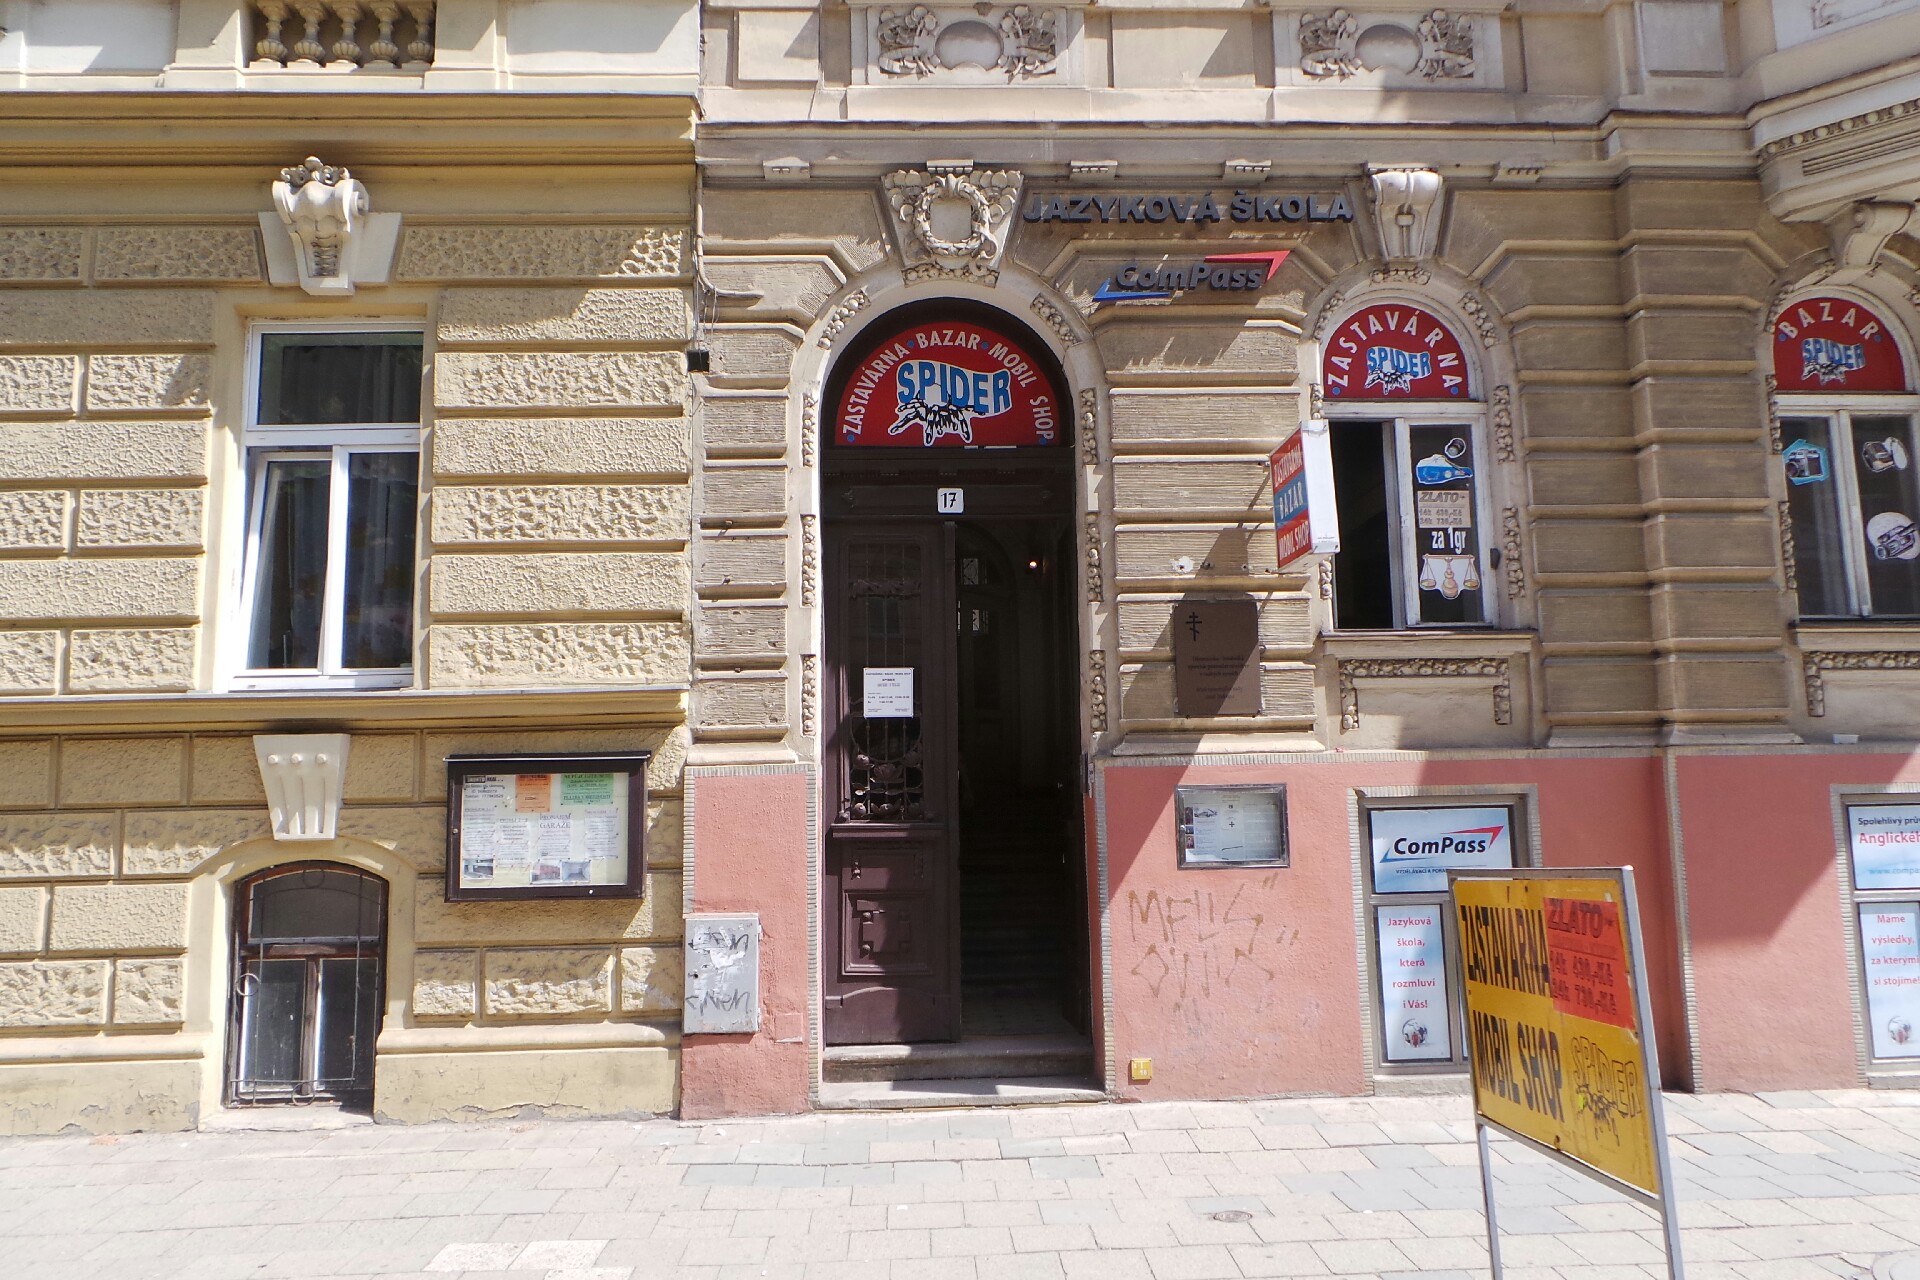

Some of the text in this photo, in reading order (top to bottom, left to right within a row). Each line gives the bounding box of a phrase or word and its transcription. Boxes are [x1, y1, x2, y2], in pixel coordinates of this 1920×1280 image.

[1023, 190, 1353, 224] JAZYKOVÁ ŠKOLA
[1115, 261, 1265, 290] ComPass
[1778, 302, 1879, 340] BAZAR
[1328, 310, 1462, 388] ZASTAVÁRNA
[1368, 347, 1430, 378] SPIDER
[1803, 339, 1866, 369] SPIDER
[843, 329, 1055, 439] ZASTAVÁRNA BAZAR MOBIL SHOP
[897, 361, 1011, 414] SPIDER
[941, 492, 957, 508] 17
[1279, 481, 1304, 520] BAZAR
[1419, 492, 1459, 503] ZLATO
[1295, 521, 1310, 552] SHOP
[1432, 531, 1445, 548] za
[1858, 817, 1903, 826] Spolehlivý
[1394, 837, 1486, 855] ComPass
[1387, 916, 1432, 929] Jazyková
[1547, 898, 1603, 938] ZLATO
[1397, 937, 1425, 947] škola,
[1400, 958, 1425, 967] která
[1392, 977, 1436, 988] rozmluví
[1874, 977, 1880, 985] si
[1408, 1000, 1428, 1009] Vás!
[1473, 1010, 1564, 1122] MOBIL SHOP
[1571, 1036, 1642, 1118] SPIDER
